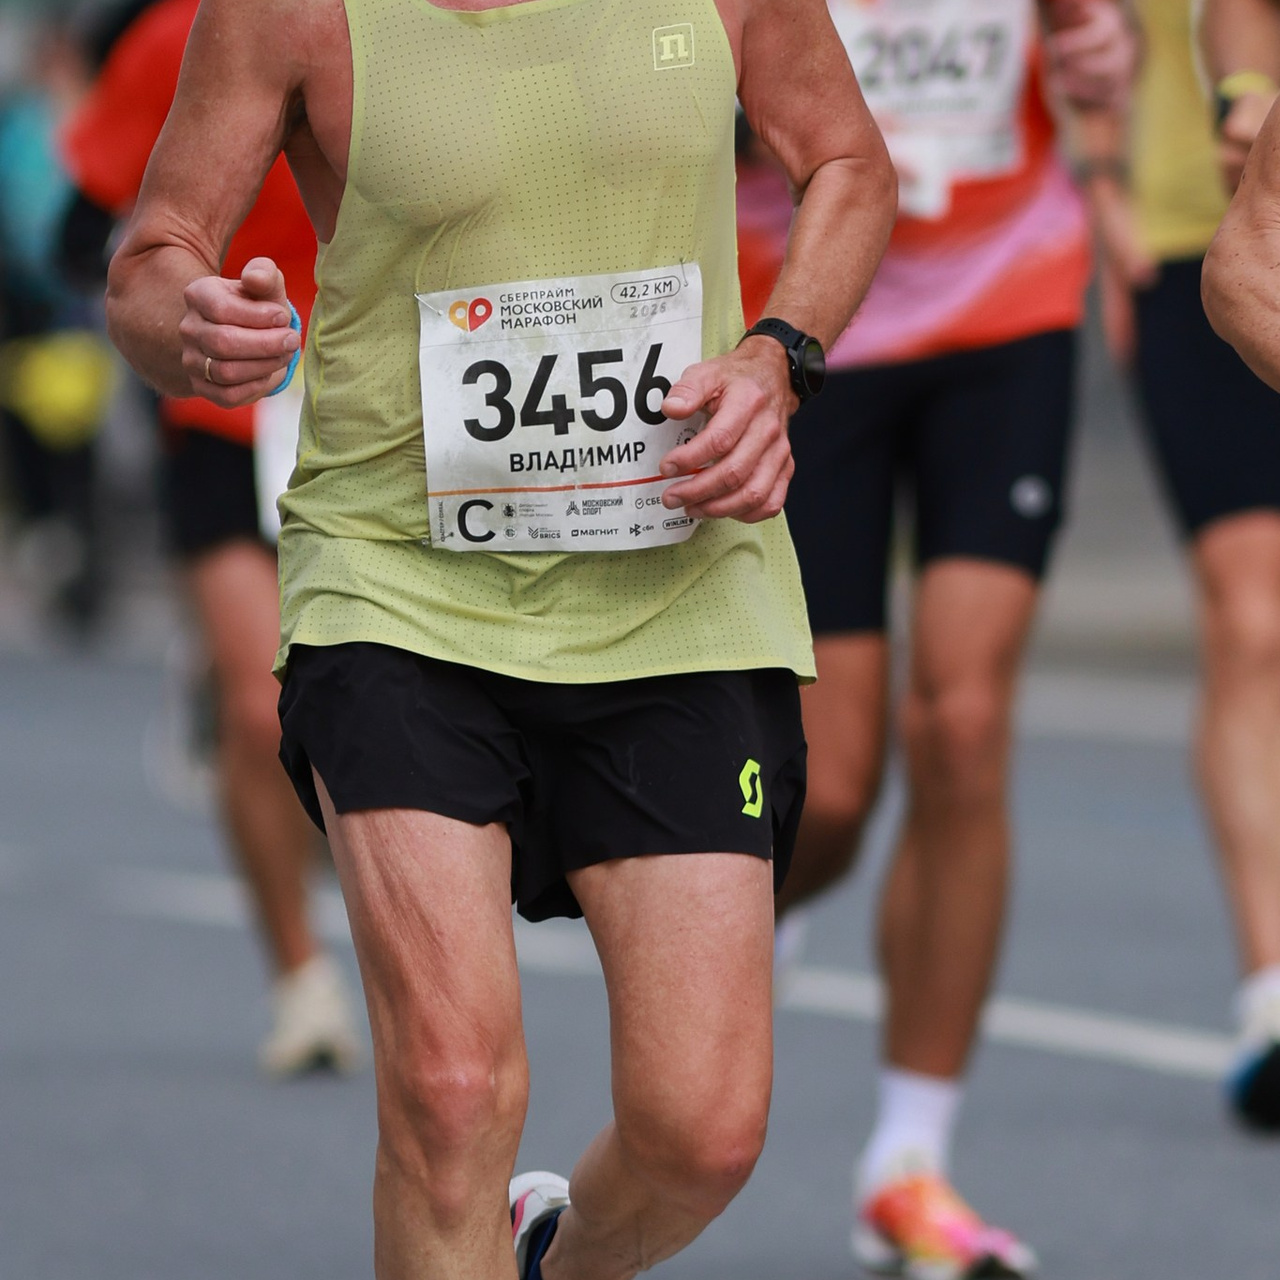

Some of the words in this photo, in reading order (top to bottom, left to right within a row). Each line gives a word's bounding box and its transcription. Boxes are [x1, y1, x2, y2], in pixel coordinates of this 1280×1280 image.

[855, 22, 1007, 90] 2047
[499, 287, 576, 303] СБЕРПРАЙМ
[619, 285, 650, 299] 42,2
[653, 280, 674, 295] КМ
[500, 294, 604, 317] МОСКОВСКИЙ
[501, 312, 577, 330] МАРАФОН
[461, 342, 673, 442] 3456
[509, 440, 646, 473] ВЛАДИМИР
[582, 496, 624, 508] МОСКОВСКИЙ
[582, 507, 602, 516] СПОРТ
[457, 498, 497, 543] C
[580, 528, 619, 536] магнит
